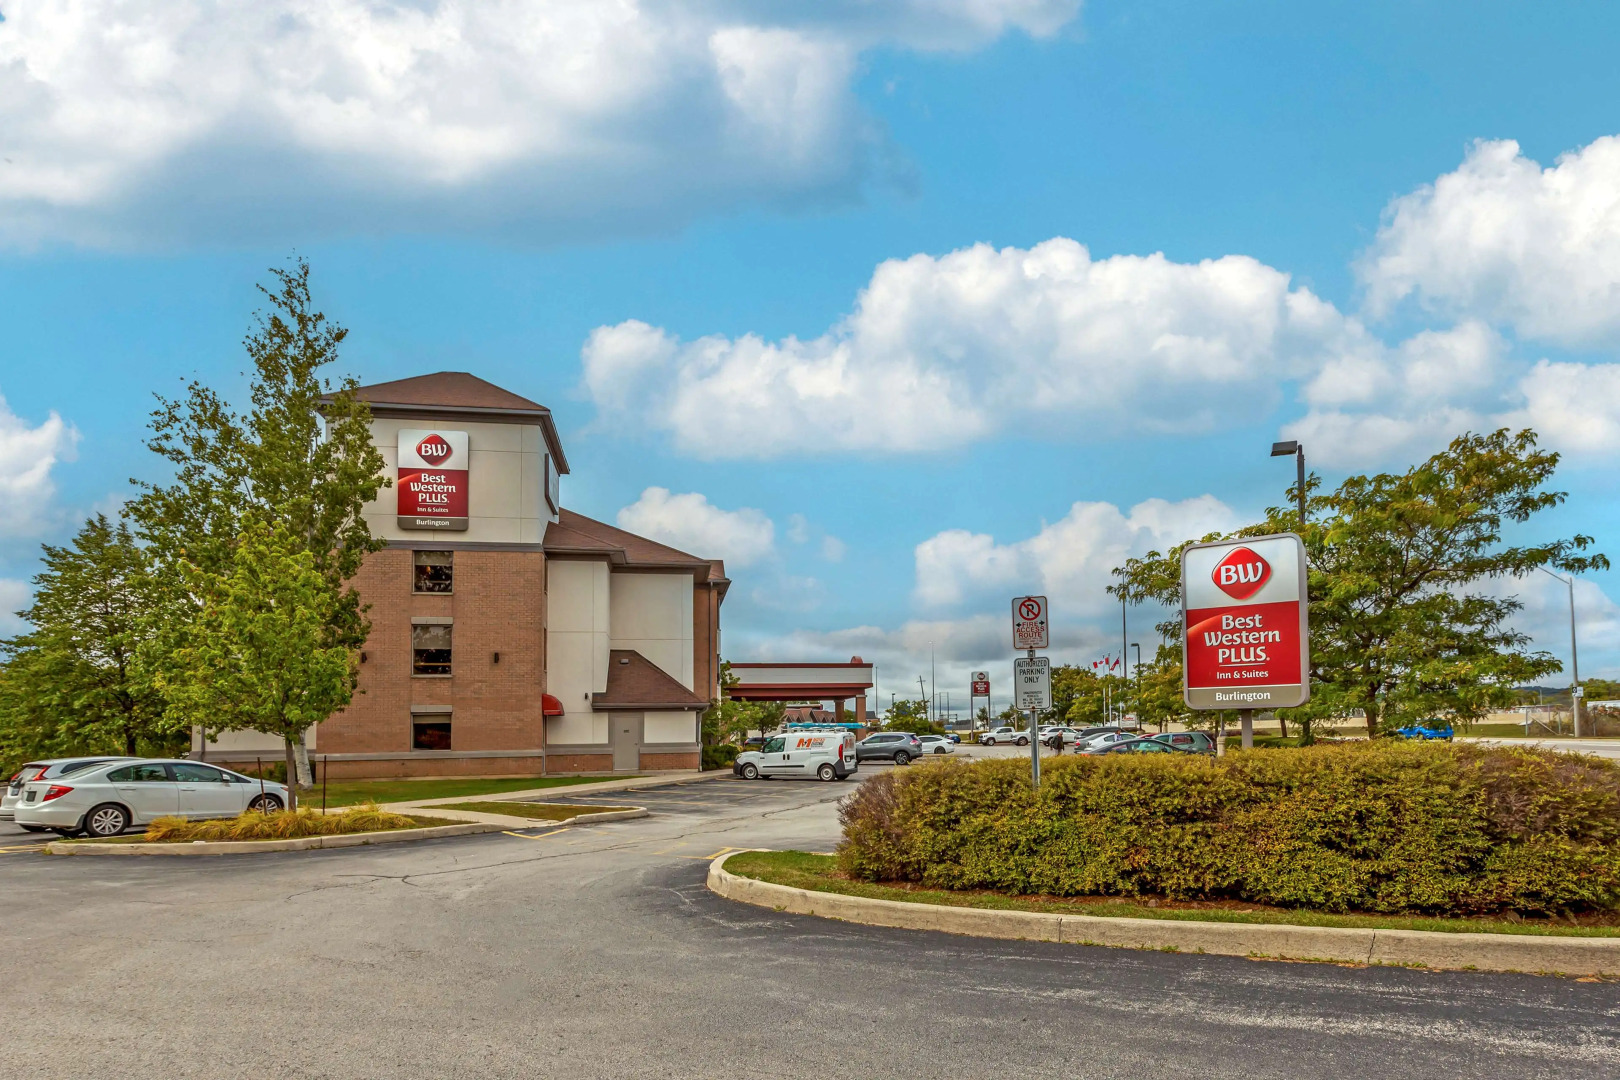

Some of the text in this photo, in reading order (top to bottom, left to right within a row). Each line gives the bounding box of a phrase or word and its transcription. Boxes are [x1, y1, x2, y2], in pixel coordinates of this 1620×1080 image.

[421, 443, 447, 456] BW
[421, 473, 446, 483] Best
[410, 482, 456, 492] Western
[1220, 561, 1263, 585] BW
[1222, 613, 1262, 630] Best
[1204, 630, 1280, 646] Western
[1216, 671, 1232, 679] Inn
[1242, 670, 1269, 679] Suites
[1216, 691, 1270, 702] Burlington
